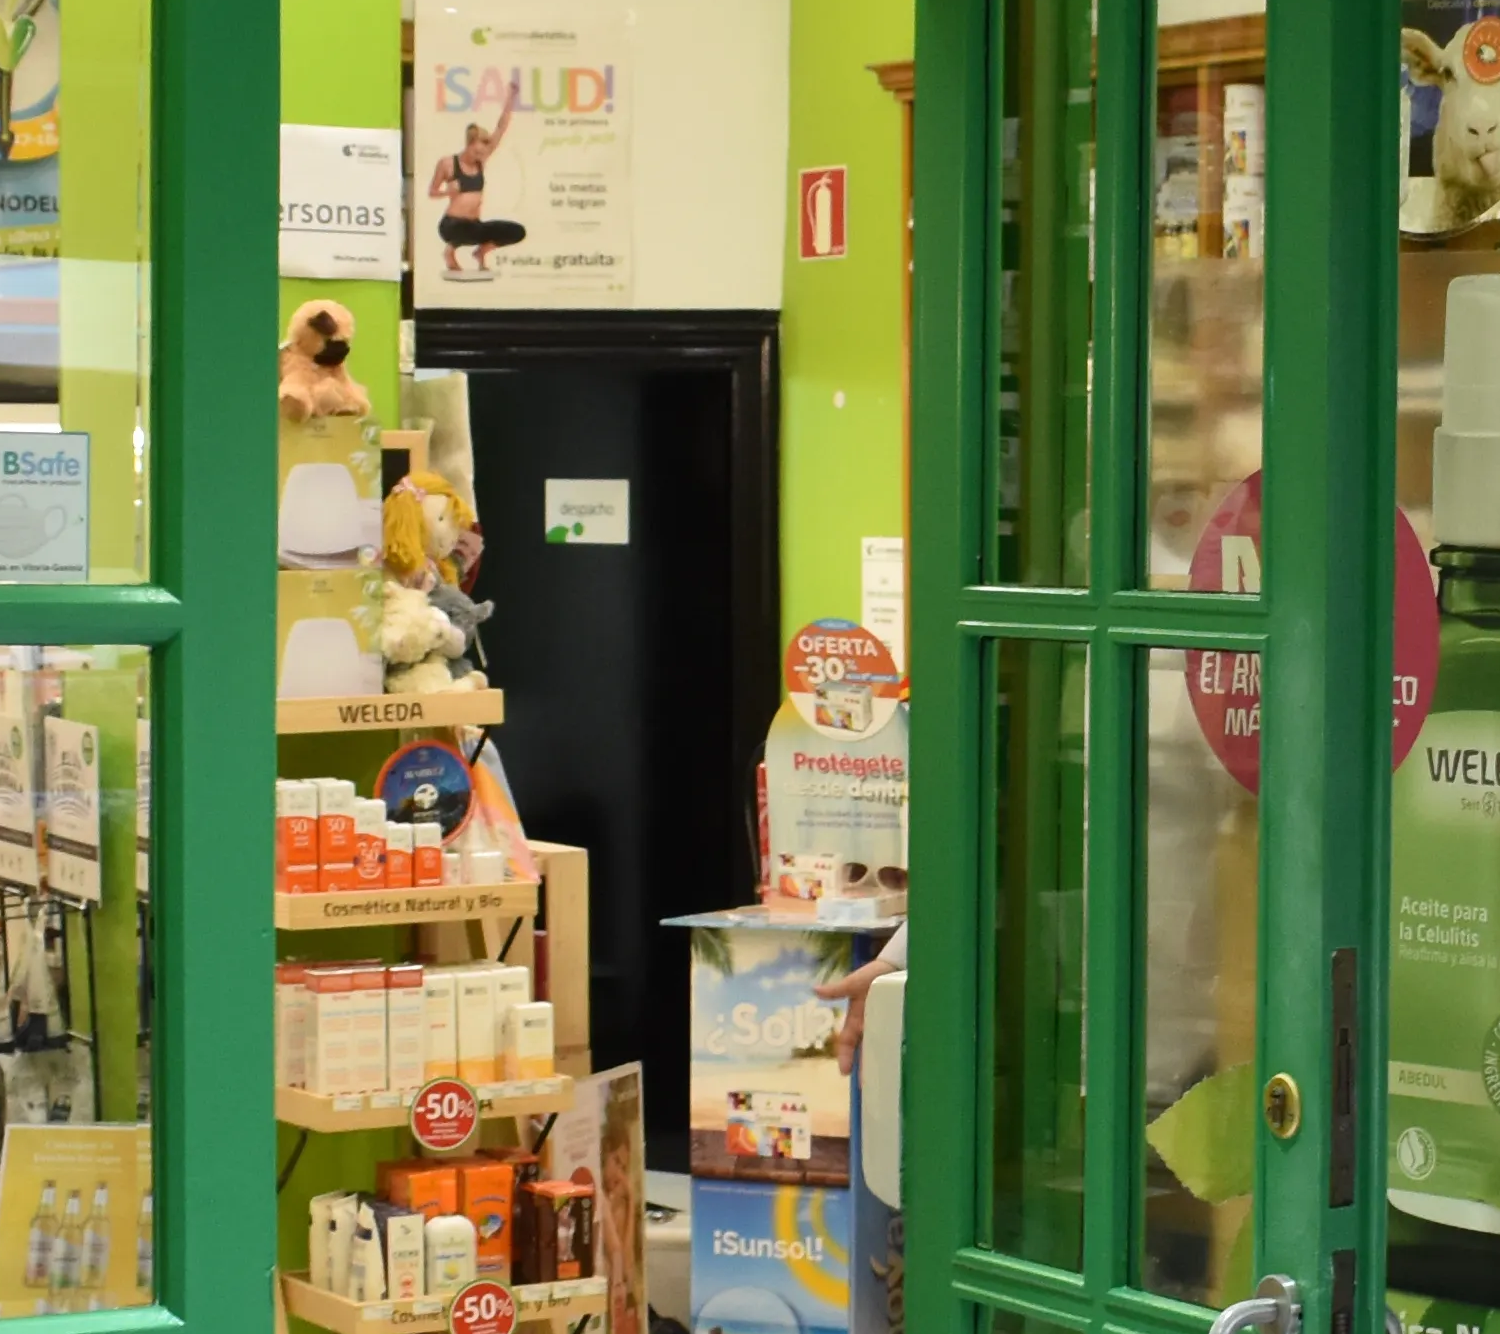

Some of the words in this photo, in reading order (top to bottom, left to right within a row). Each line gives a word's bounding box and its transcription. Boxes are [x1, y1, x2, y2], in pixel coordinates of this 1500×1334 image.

[434, 63, 615, 115] ¡SALUD!
[2, 450, 81, 478] BSafe
[797, 634, 879, 658] OFERTA
[338, 702, 424, 724] WELEDA
[323, 896, 400, 917] Cosmética
[405, 896, 461, 914] Natural
[465, 897, 475, 912] y
[1400, 896, 1451, 919] Aceite
[1452, 903, 1489, 924] para
[1399, 921, 1414, 941] la
[1416, 923, 1480, 949] Celulitis
[704, 999, 836, 1056] ¿Sol?
[1398, 1069, 1448, 1090] ABEDUL
[414, 1091, 476, 1121] -50%
[712, 1228, 824, 1263] ¡Sunsol!
[454, 1291, 514, 1324] -50%
